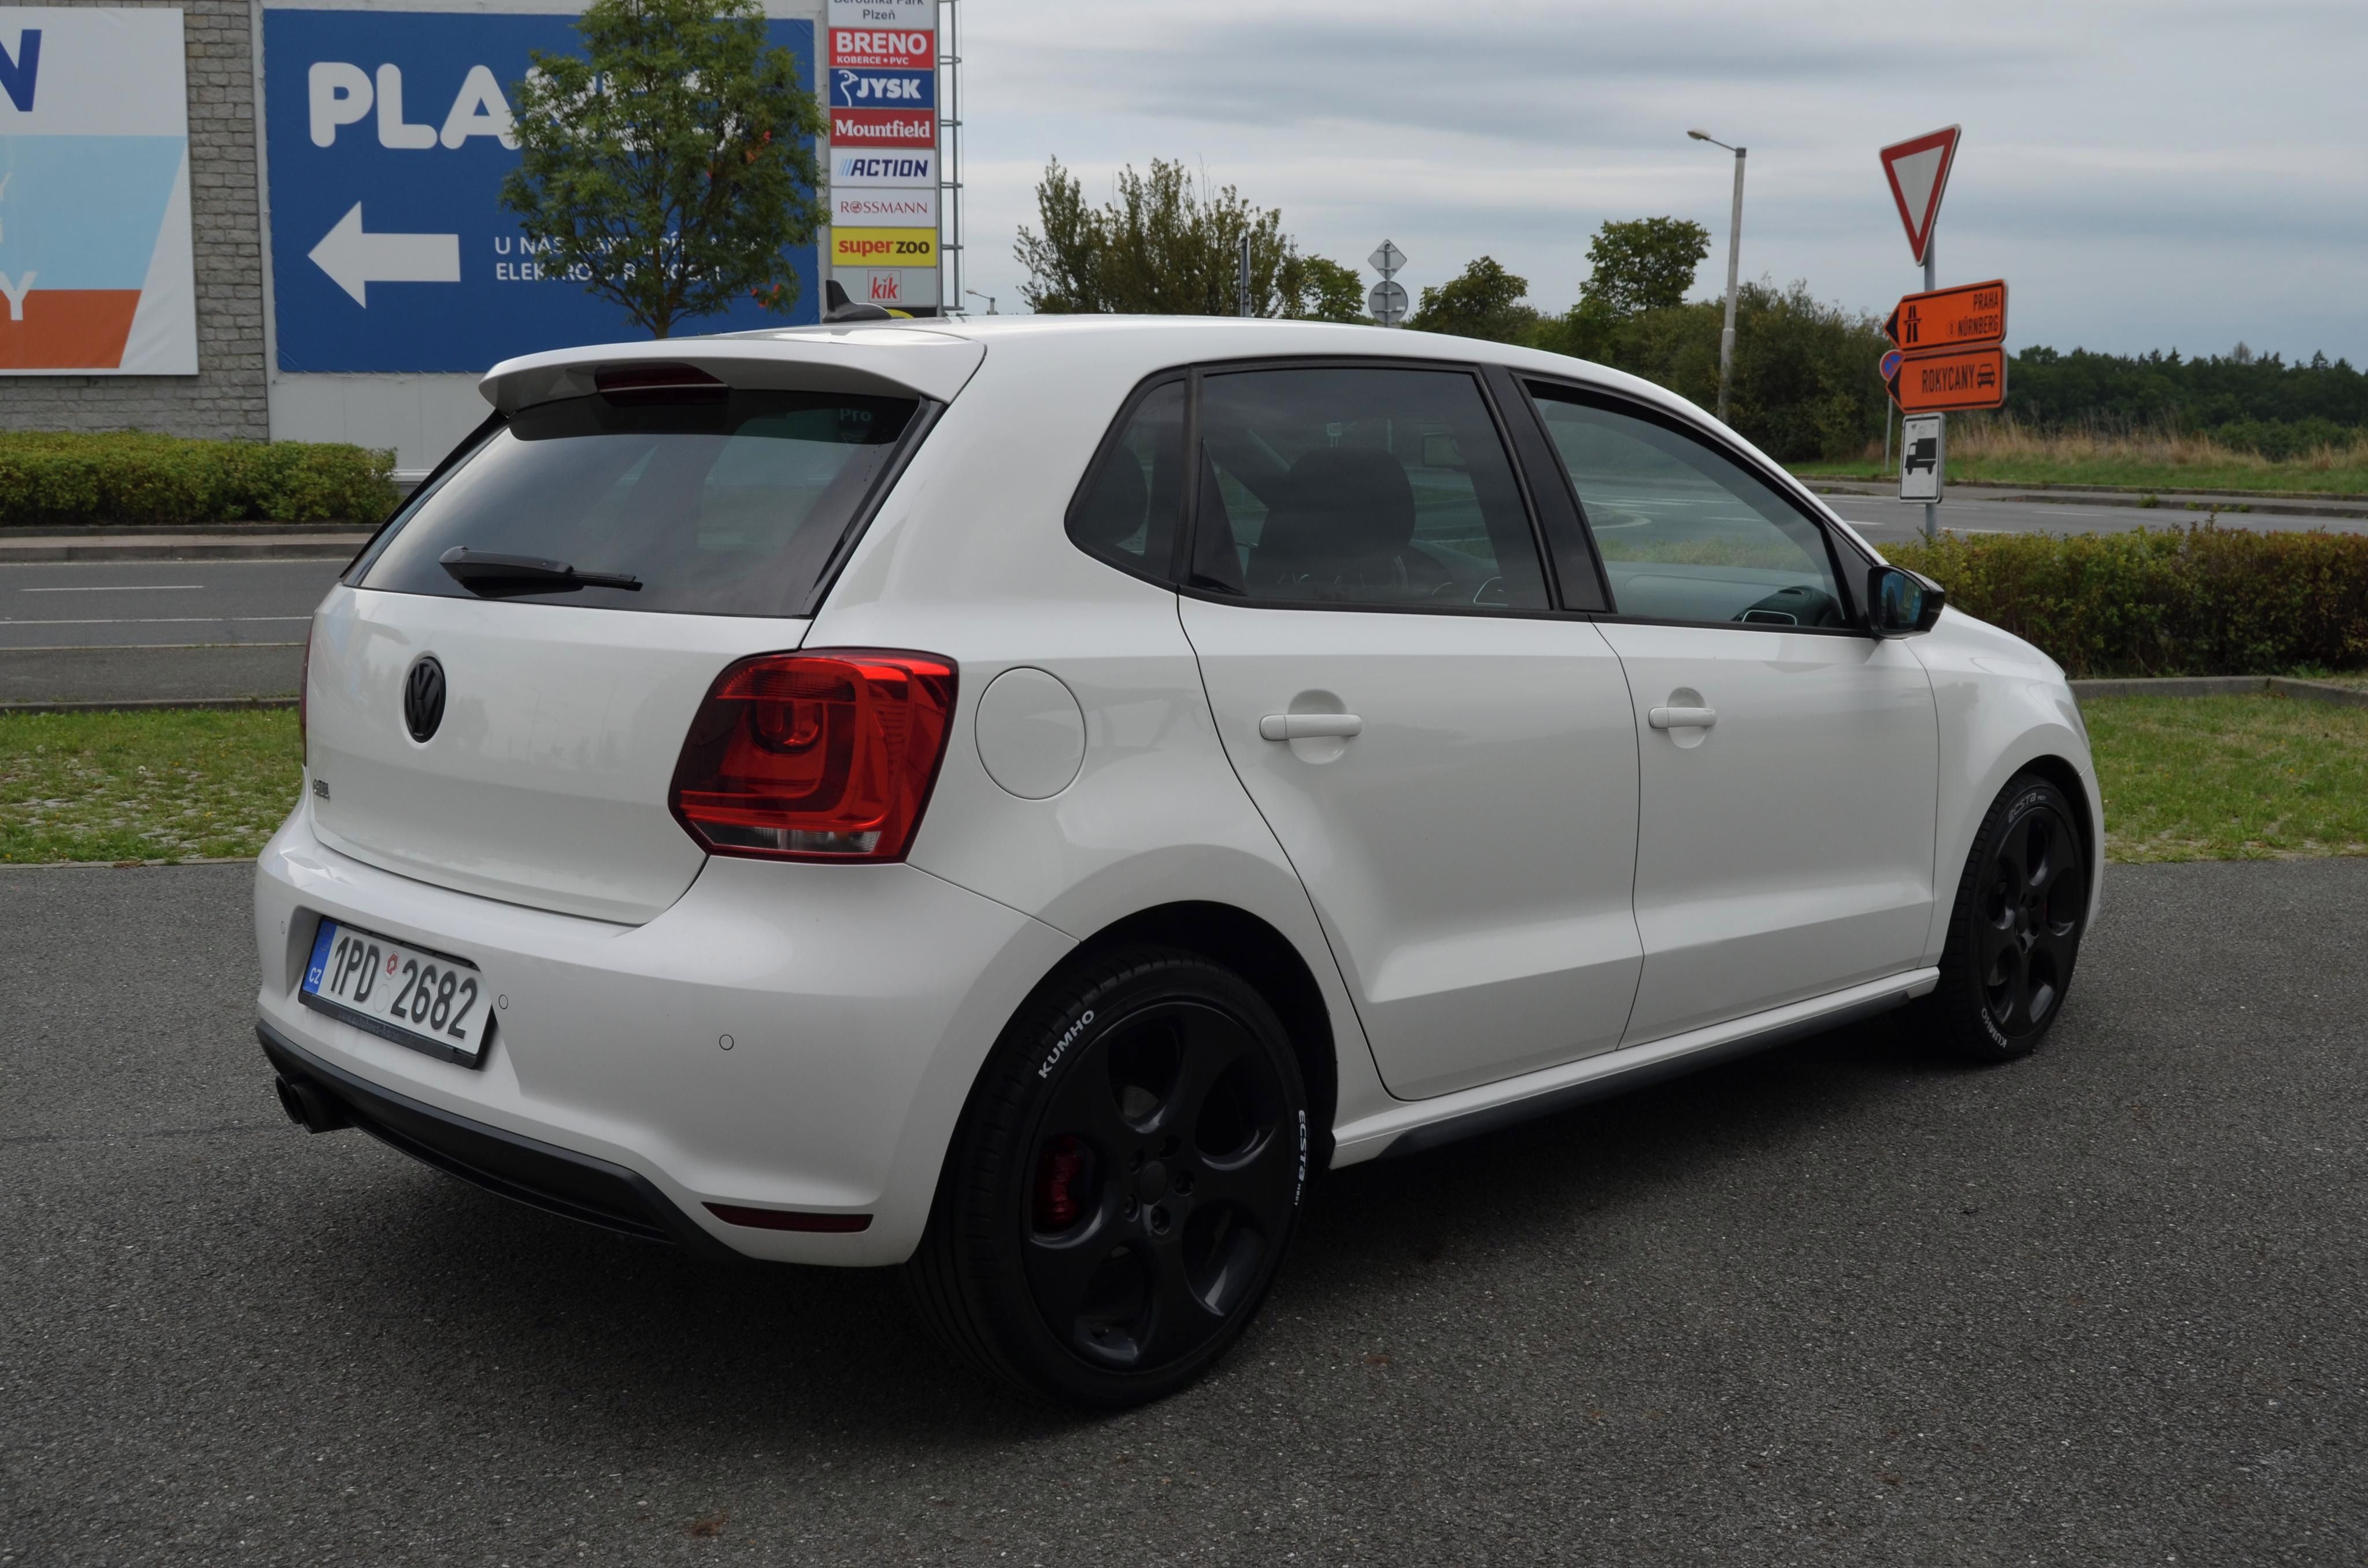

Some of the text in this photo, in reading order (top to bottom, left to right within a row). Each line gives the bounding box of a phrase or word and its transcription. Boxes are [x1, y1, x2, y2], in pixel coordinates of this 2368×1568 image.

[863, 9, 896, 20] Plzeň
[836, 32, 927, 55] BRENO
[856, 78, 922, 98] JYSK
[835, 120, 930, 138] Mountfield
[850, 159, 928, 177] ACTION
[841, 201, 927, 213] ROSSMANN
[495, 236, 510, 254] U
[496, 262, 593, 281] ELEKRO
[1973, 291, 1999, 312] PRAHA
[1958, 315, 1999, 338] NÜRNBERG
[1922, 364, 1975, 394] ROKYCANY
[840, 408, 872, 421] Pro
[309, 966, 323, 985] CZ
[330, 936, 478, 1040] 1PD 2682
[1981, 1007, 2007, 1048] KUMHO
[1038, 1010, 1094, 1078] KUMHO
